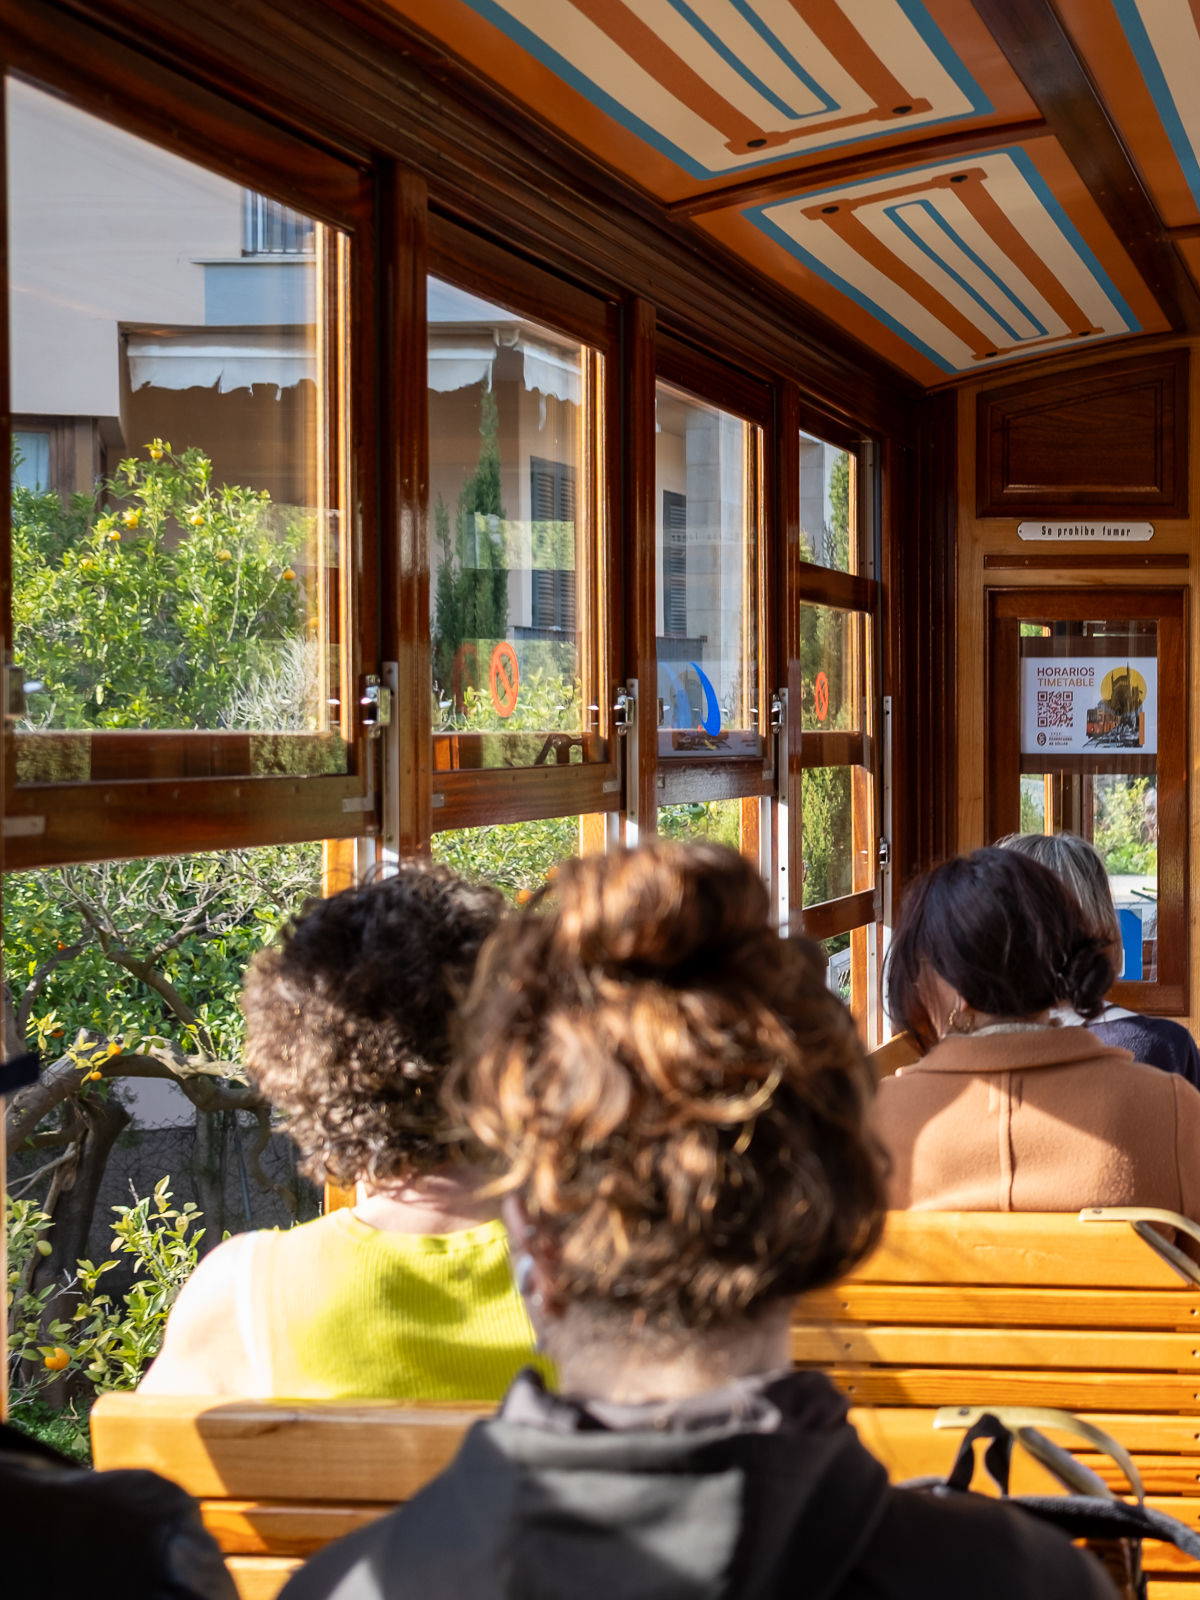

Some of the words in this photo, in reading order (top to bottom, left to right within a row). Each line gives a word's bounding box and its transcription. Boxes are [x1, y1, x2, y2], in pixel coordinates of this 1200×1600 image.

[1041, 525, 1052, 536] Se
[1057, 525, 1095, 538] prohibe
[1102, 525, 1131, 537] fumar
[1037, 666, 1095, 677] HORARIOS
[1037, 677, 1095, 687] TIMETABLE
